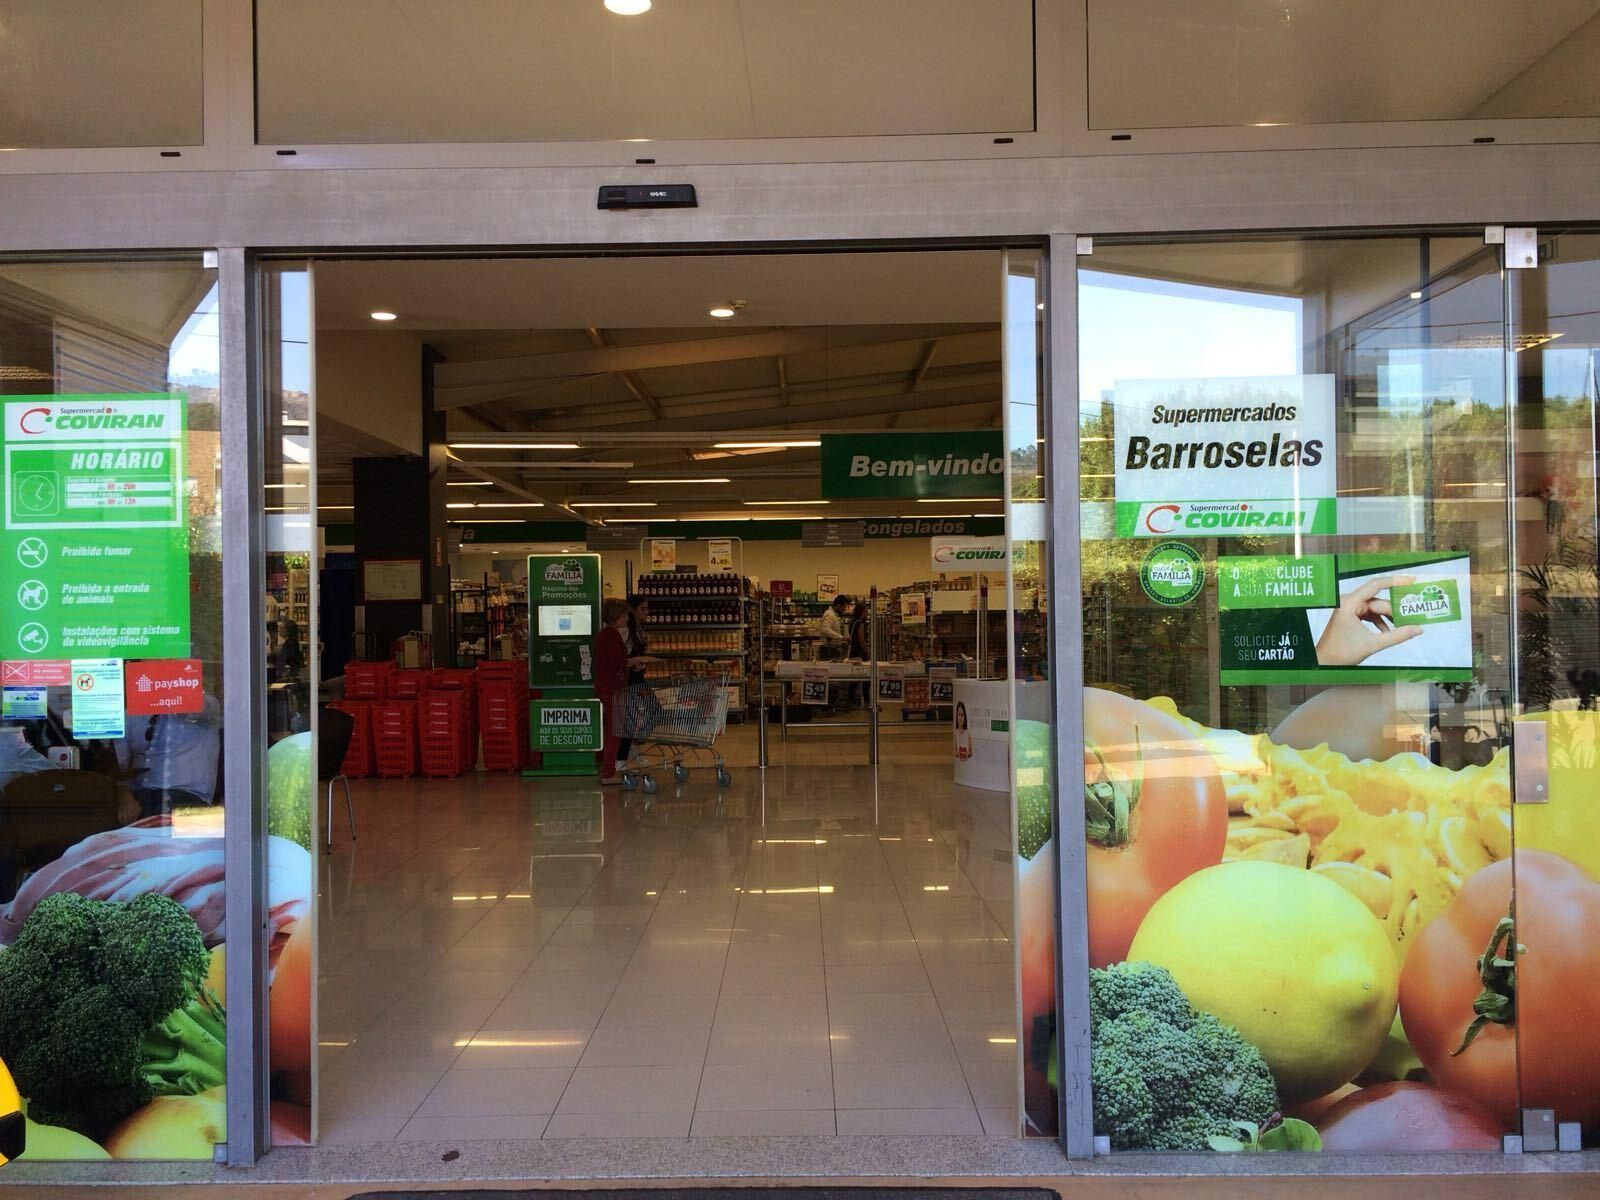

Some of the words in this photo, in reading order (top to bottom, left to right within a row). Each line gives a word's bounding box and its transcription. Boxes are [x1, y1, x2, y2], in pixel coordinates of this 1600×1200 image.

[60, 407, 117, 415] Supermercados
[1151, 402, 1297, 428] Supermercados
[55, 414, 164, 430] COVIRAN
[1125, 432, 1324, 470] Barroselas
[70, 449, 164, 470] HORÁRIO
[850, 452, 1005, 477] Bem-vindo
[1190, 503, 1254, 512] Supermercados
[1184, 511, 1306, 529] COVIRAN
[61, 546, 102, 556] Proibido
[104, 546, 133, 556] fumar
[956, 550, 1006, 560] COVIR
[1276, 565, 1314, 579] CLUBE
[61, 583, 102, 593] Proibida
[104, 585, 110, 593] a
[112, 583, 151, 593] entrada
[1233, 583, 1241, 597] A
[1265, 578, 1314, 597] FAMÍLIA
[62, 594, 75, 604] de
[76, 594, 114, 604] animais
[542, 591, 586, 600] Promoções
[1402, 596, 1421, 605] clube
[62, 626, 118, 637] Instalações
[119, 627, 141, 635] com
[142, 625, 180, 635] sistema
[62, 637, 75, 647] de
[77, 635, 149, 648] videovigilância
[1234, 634, 1277, 647] SOLICITE
[1278, 632, 1291, 647] JÁ
[1292, 634, 1299, 646] O
[1238, 649, 1257, 661] SEU
[1258, 647, 1295, 661] CARTÃO
[154, 677, 199, 690] payshop
[543, 709, 589, 724] IMPRIMA
[539, 735, 550, 745] DE
[552, 735, 593, 745] DESCONTO
